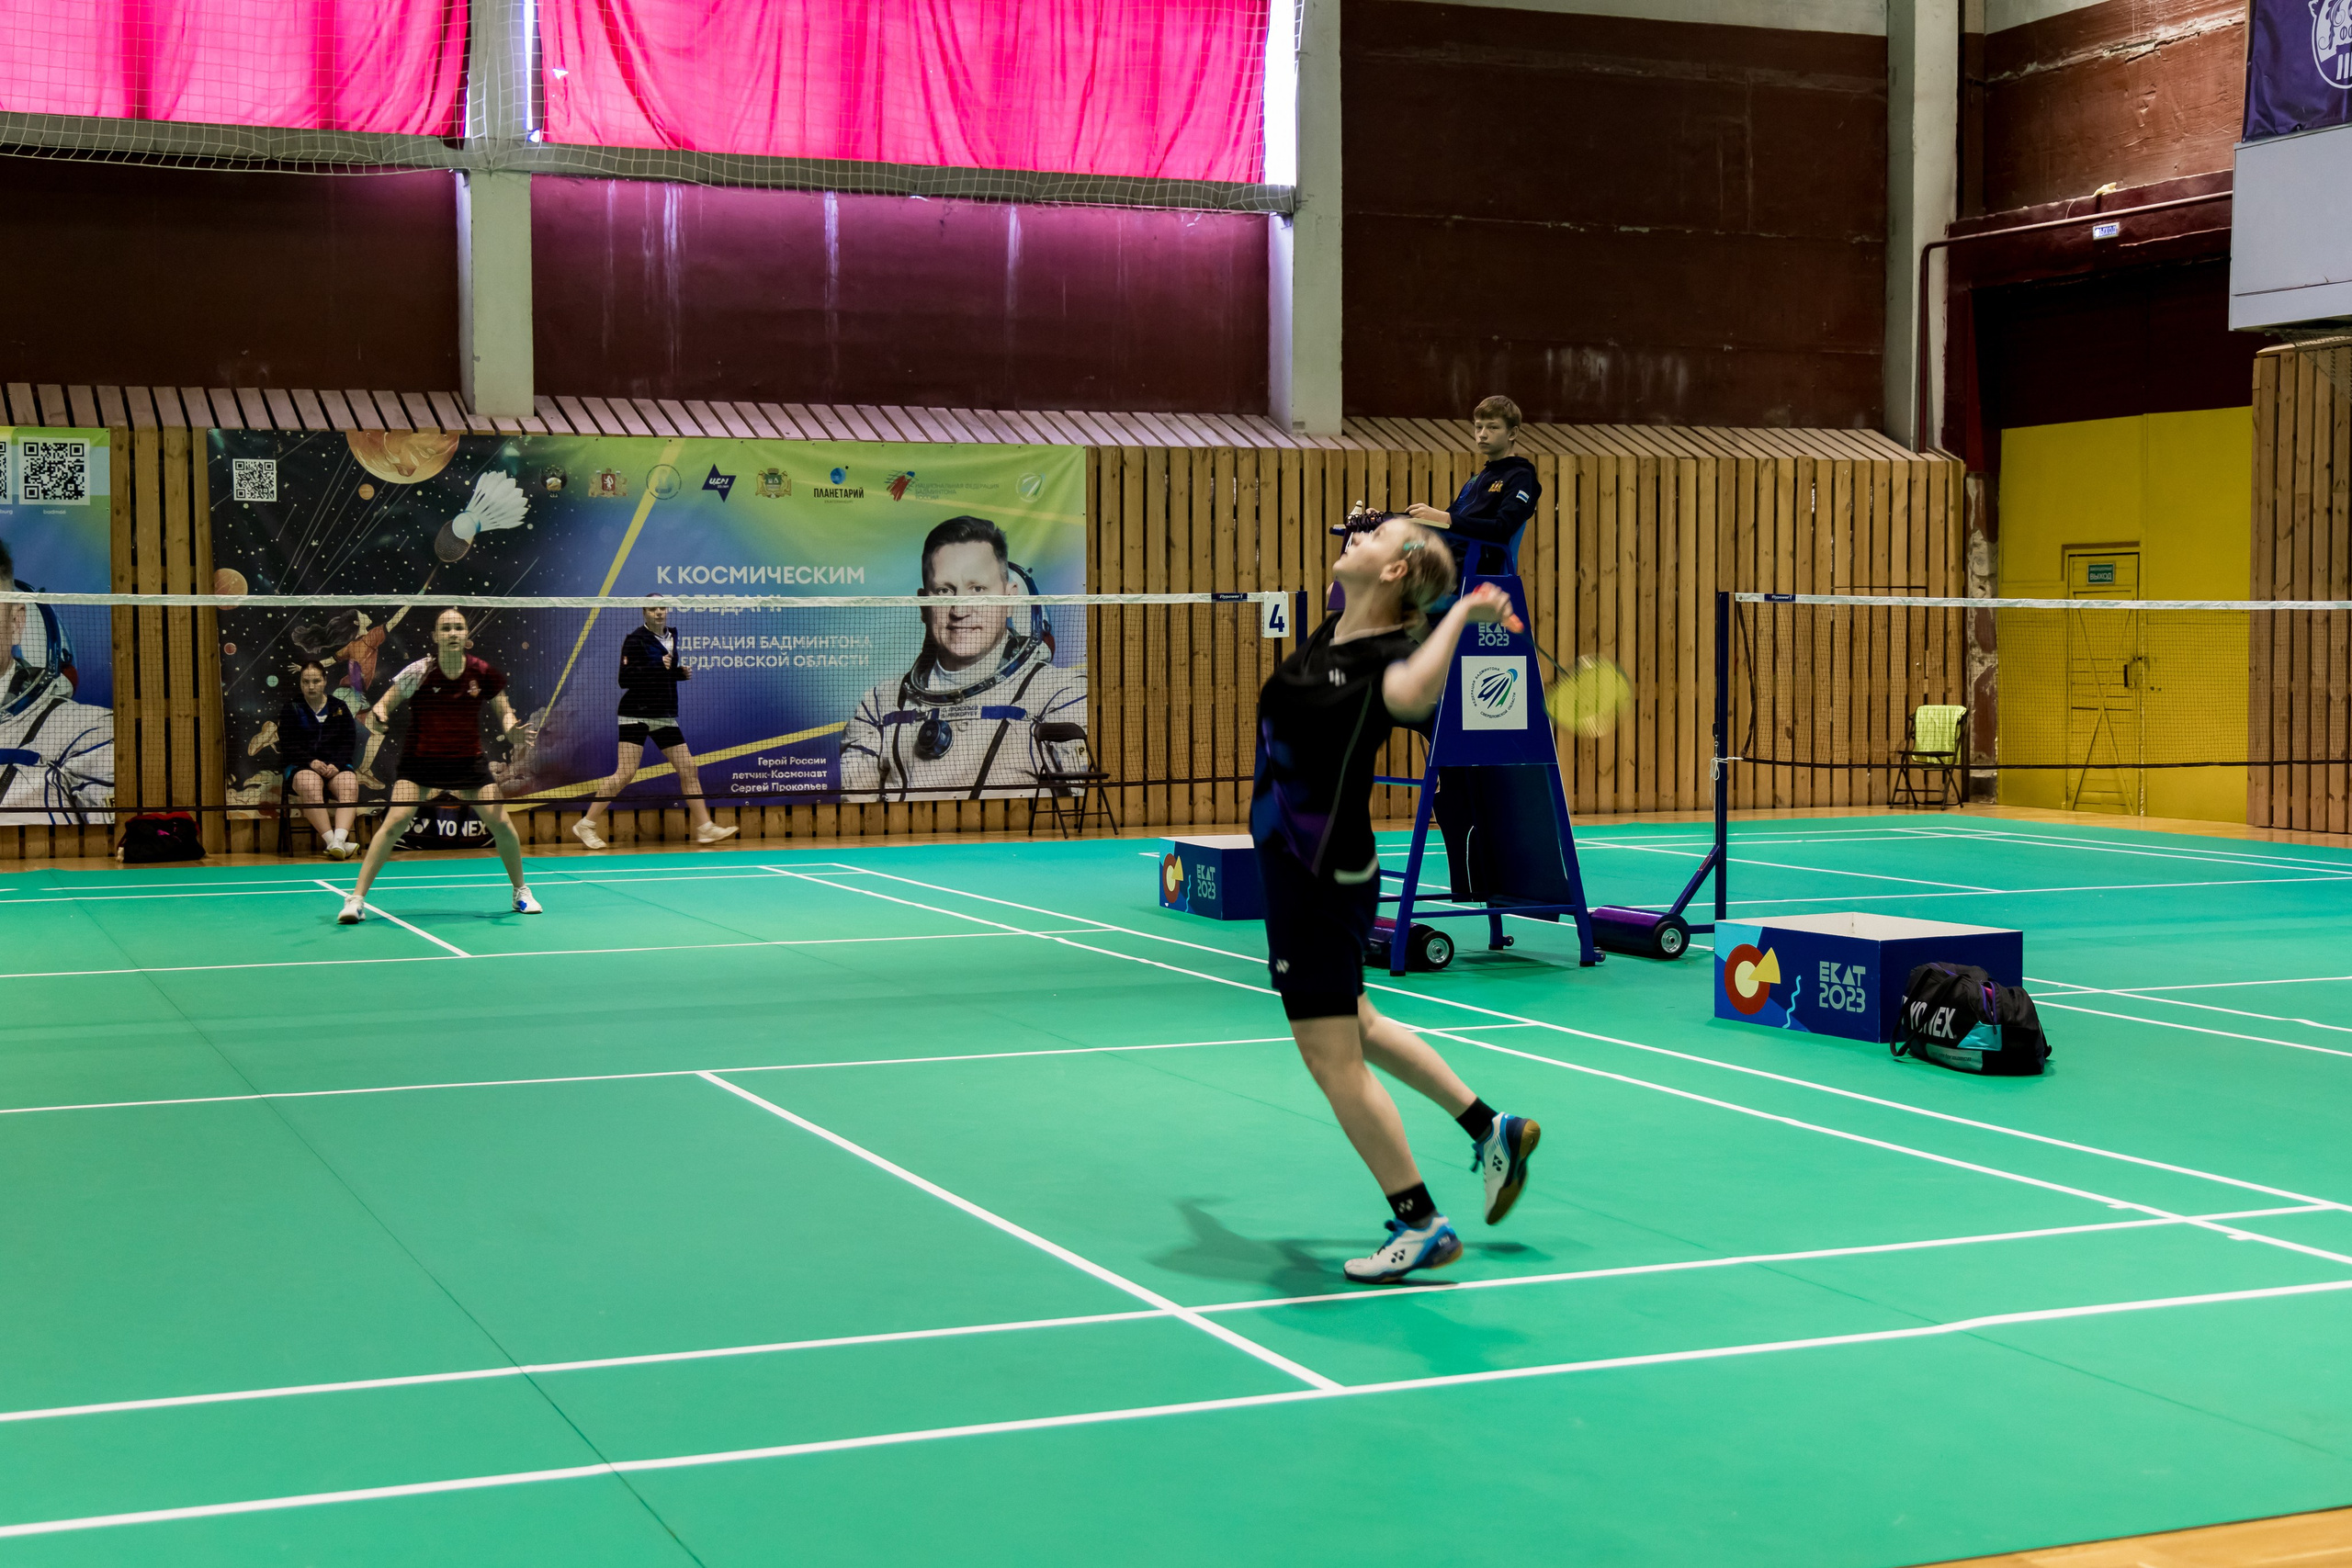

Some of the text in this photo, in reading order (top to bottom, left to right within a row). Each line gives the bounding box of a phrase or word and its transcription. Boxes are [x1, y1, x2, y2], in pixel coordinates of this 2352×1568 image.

[2095, 226, 2117, 238] ЫХОД
[813, 487, 865, 499] ПЛАНЕТАРИЙ
[657, 566, 865, 584] К КОСМИЧЕСКИМ
[1269, 604, 1285, 633] 4
[1478, 622, 1507, 634] EKAT
[677, 635, 872, 651] ДЕРАЦИЯ БАДМИНТОНА
[1478, 633, 1510, 647] 2023
[677, 652, 869, 671] ЕРДЛОВСКОЙ ОБЛАСТИ
[758, 756, 827, 768] Герой России
[732, 770, 828, 780] летчик-Космонавт
[730, 782, 828, 794] Сергей Прокопьев
[1196, 863, 1216, 882] EKAT
[1197, 878, 1216, 900] 2023
[1819, 960, 1866, 987] EKAT
[1818, 982, 1866, 1013] 2023
